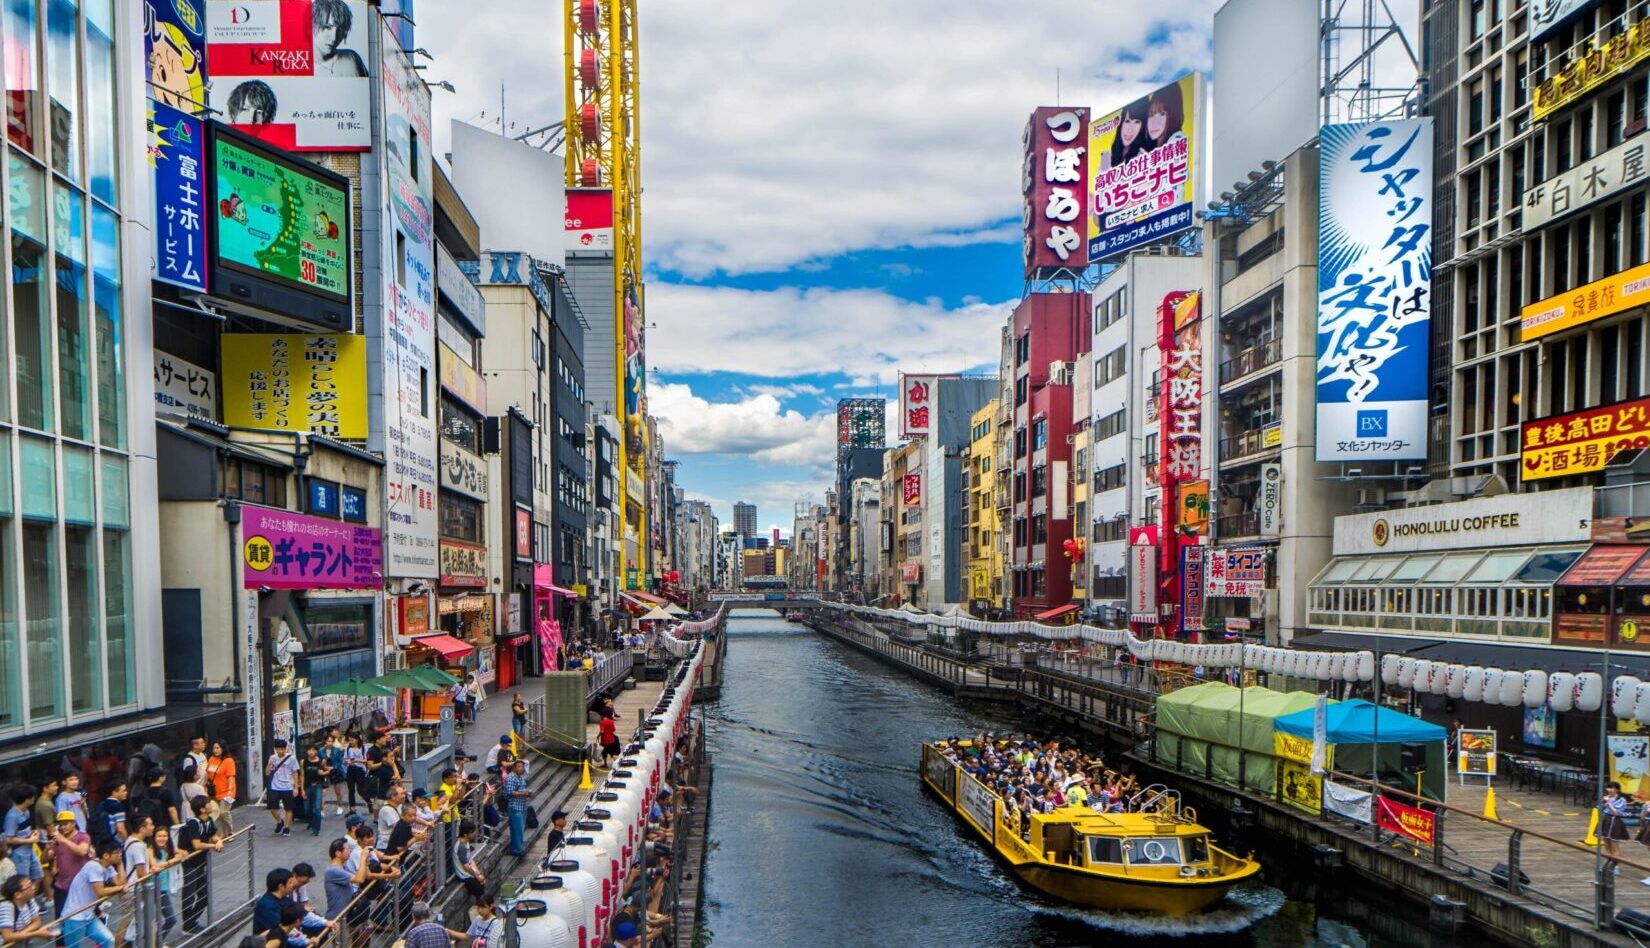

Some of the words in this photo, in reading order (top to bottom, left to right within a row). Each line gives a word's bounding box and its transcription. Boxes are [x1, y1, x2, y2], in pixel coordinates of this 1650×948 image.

[250, 48, 309, 65] KANZAKI
[272, 58, 310, 74] RUKA
[292, 111, 356, 120] めっちゃ面白いを
[1046, 108, 1086, 261] づぼらや
[1094, 155, 1188, 214] いちごナビ
[1095, 137, 1188, 191] 高収入お仕事情報
[1526, 187, 1546, 209] 4F
[1552, 144, 1646, 217] 白木屋
[163, 204, 179, 272] サービス
[178, 153, 202, 284] 富士ホーム
[302, 260, 317, 283] 30
[249, 370, 269, 421] 応援します
[271, 338, 290, 428] あなたのお店づくり
[304, 337, 340, 437] 素晴らしい夢の実現
[1167, 343, 1202, 478] 大阪王将
[1361, 417, 1383, 431] BX
[1543, 443, 1601, 472] 酒場
[1394, 518, 1460, 537] HONOLULU
[1463, 512, 1520, 531] COFFEE
[248, 543, 270, 563] 賃貸
[275, 536, 353, 578] ギャラント
[1228, 553, 1262, 570] ダイコク
[1188, 563, 1199, 598] ダイコク
[1224, 581, 1246, 595] 免税
